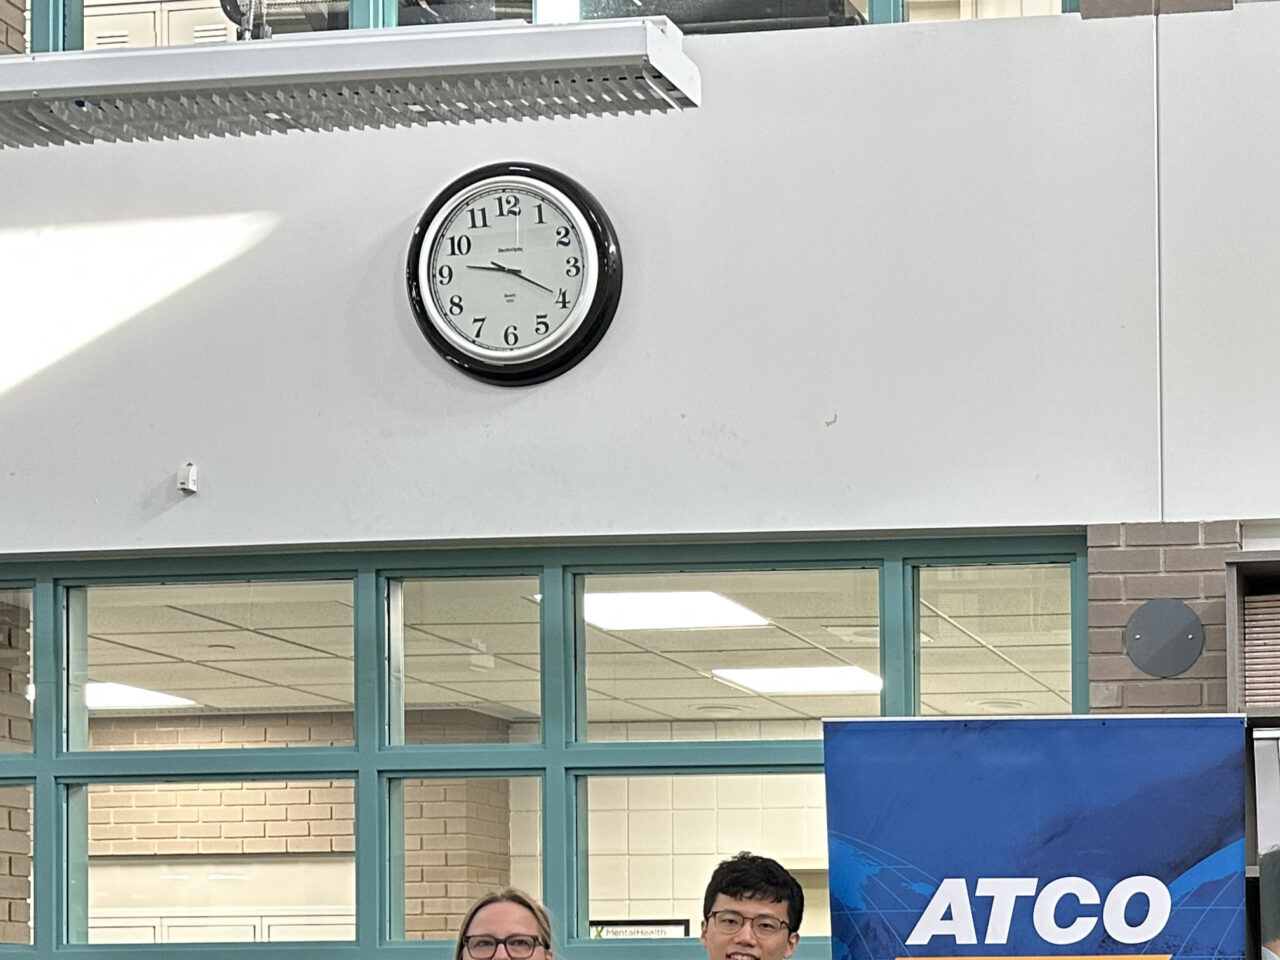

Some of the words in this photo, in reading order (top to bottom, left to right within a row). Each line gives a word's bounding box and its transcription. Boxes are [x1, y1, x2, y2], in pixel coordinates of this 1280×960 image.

[495, 194, 521, 217] 12
[533, 203, 547, 225] 1
[466, 207, 492, 229] 11
[447, 234, 472, 256] 10
[556, 226, 571, 247] 2
[438, 264, 453, 285] 9
[565, 256, 581, 277] 3
[449, 294, 464, 316] 8
[555, 287, 571, 309] 4
[472, 316, 487, 339] 7
[535, 313, 550, 335] 5
[503, 325, 519, 346] 6
[905, 875, 1172, 945] ATCO
